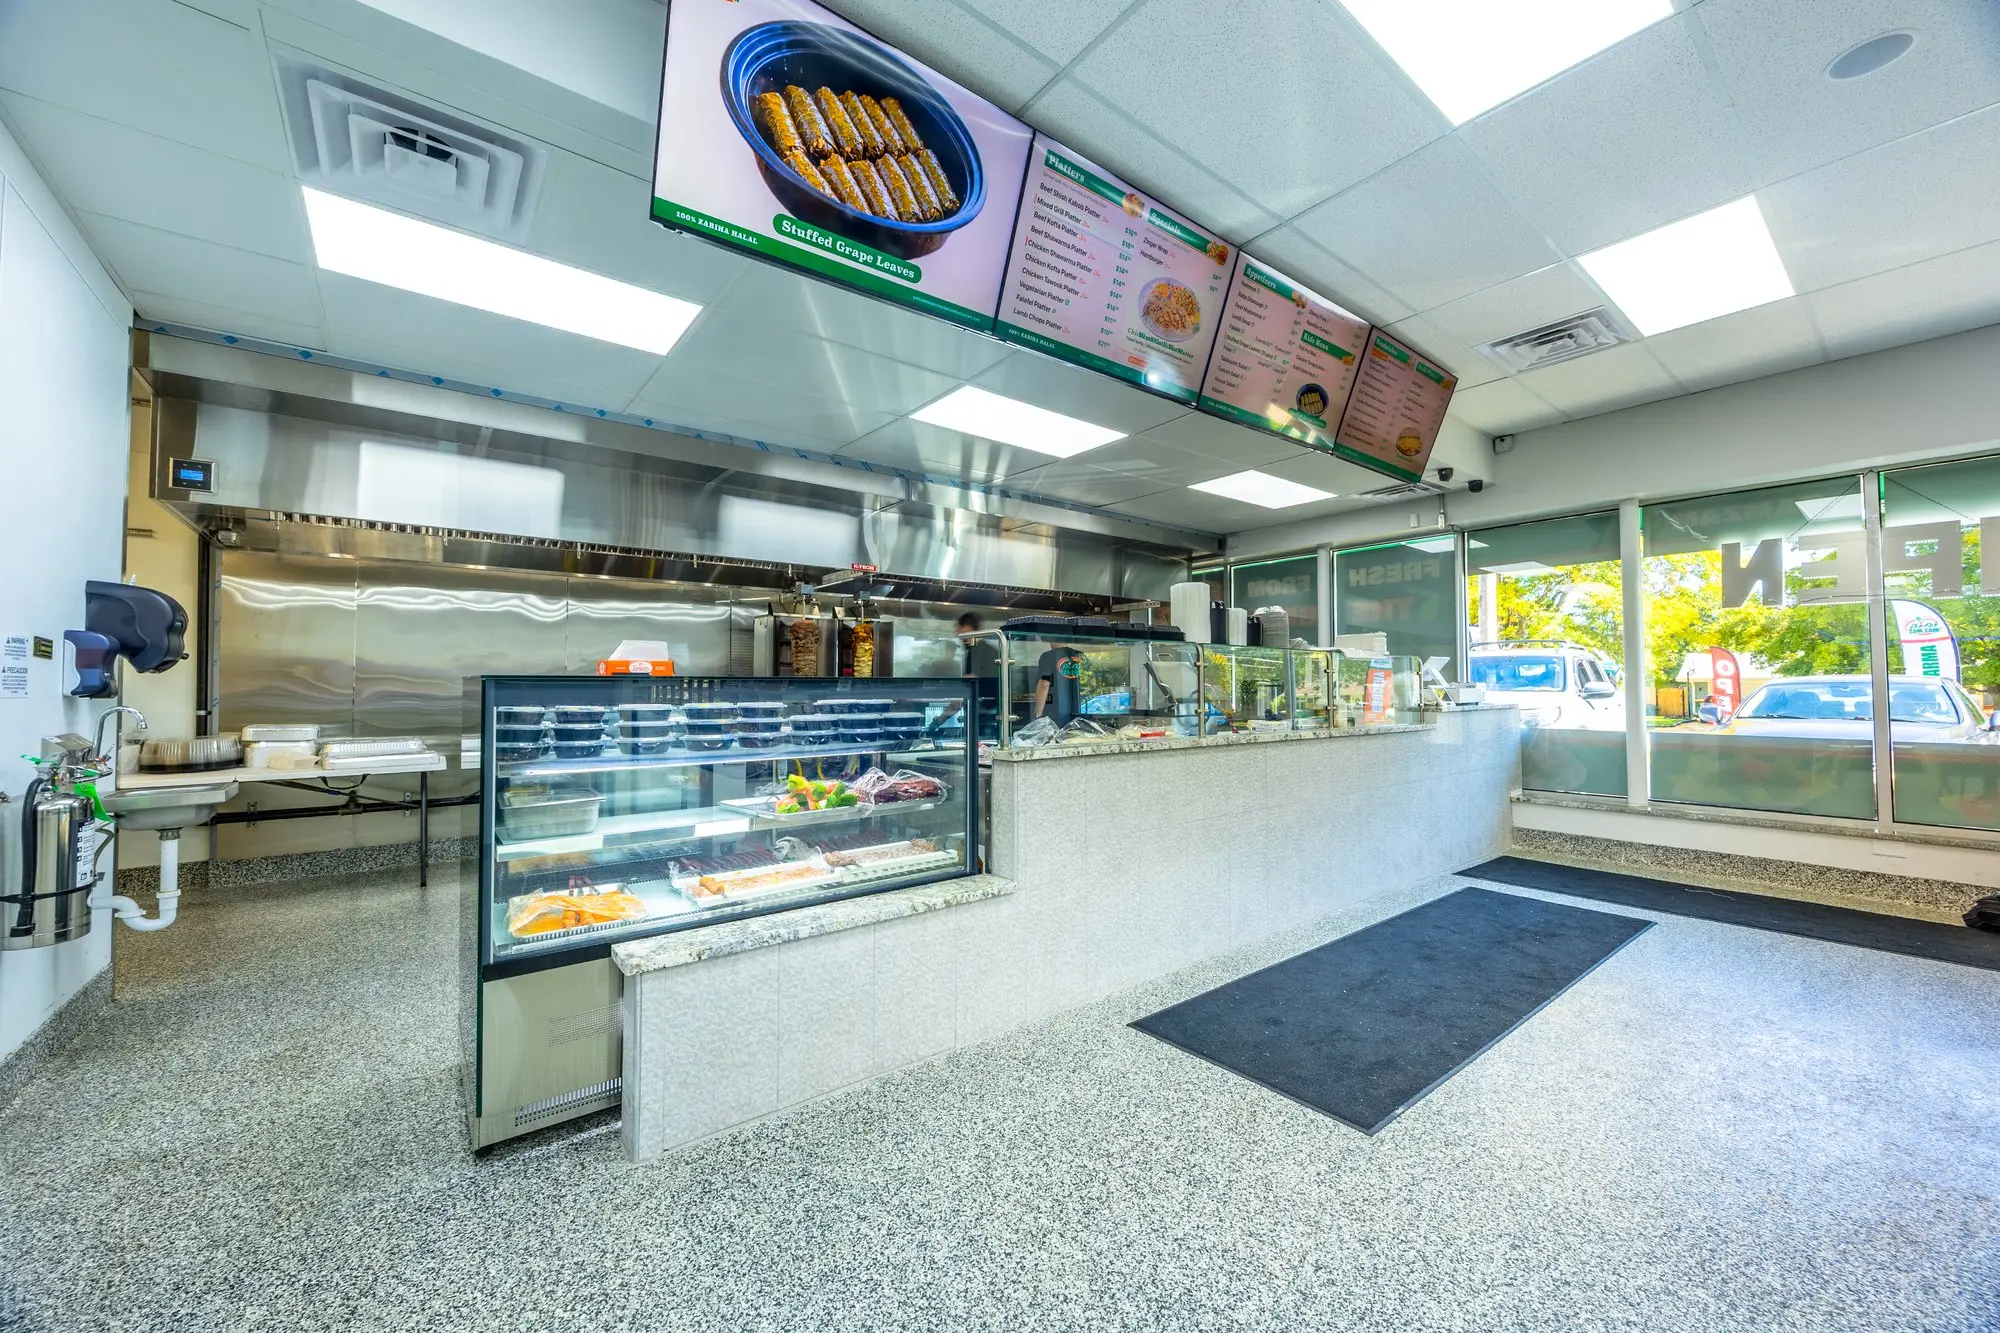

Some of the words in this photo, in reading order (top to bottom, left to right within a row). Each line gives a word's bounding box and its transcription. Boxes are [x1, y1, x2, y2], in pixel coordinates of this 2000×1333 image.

[1048, 155, 1085, 182] Platters
[1036, 197, 1053, 210] Mixed
[1053, 206, 1064, 215] Grill
[1064, 211, 1081, 224] Platter
[1039, 183, 1052, 194] Beef
[1052, 189, 1067, 202] Shish
[1068, 197, 1084, 210] Kabob
[1084, 206, 1100, 219] Platter
[676, 210, 695, 223] 100%
[698, 218, 729, 235] ZABIHA
[731, 230, 757, 245] HALAL
[1033, 212, 1046, 222] Beef
[1046, 218, 1060, 229] Kofta
[1061, 225, 1077, 237] Platter
[1151, 213, 1181, 236] Specials
[782, 220, 833, 247] Stuffed
[836, 241, 873, 266] Grape
[876, 256, 914, 278] Leaves
[1030, 226, 1043, 236] Beef
[1044, 232, 1070, 248] Shawarma
[1070, 244, 1087, 256] Platter
[1143, 237, 1157, 249] Zinger
[1157, 245, 1168, 255] Wrap
[1024, 254, 1046, 267] Chicken
[1046, 263, 1060, 273] Kofta
[1061, 269, 1077, 280] Platter
[1027, 240, 1049, 254] Chicken
[1049, 250, 1076, 266] Shawarma
[1076, 261, 1092, 273] Platter
[1139, 250, 1163, 266] Hamburger
[1022, 267, 1043, 280] Chicken
[1044, 277, 1062, 288] Tawook
[1063, 284, 1079, 296] Platter
[1246, 268, 1276, 289] Appetizers
[1016, 294, 1033, 305] Falafel
[1034, 301, 1050, 312] Platter
[1019, 281, 1047, 297] Vegetarian
[1047, 292, 1064, 303] Platter
[1013, 308, 1028, 318] Lamb
[1028, 314, 1045, 325] Chops
[1045, 320, 1062, 330] Platter
[1303, 333, 1315, 343] Kids
[1315, 339, 1329, 350] Menu
